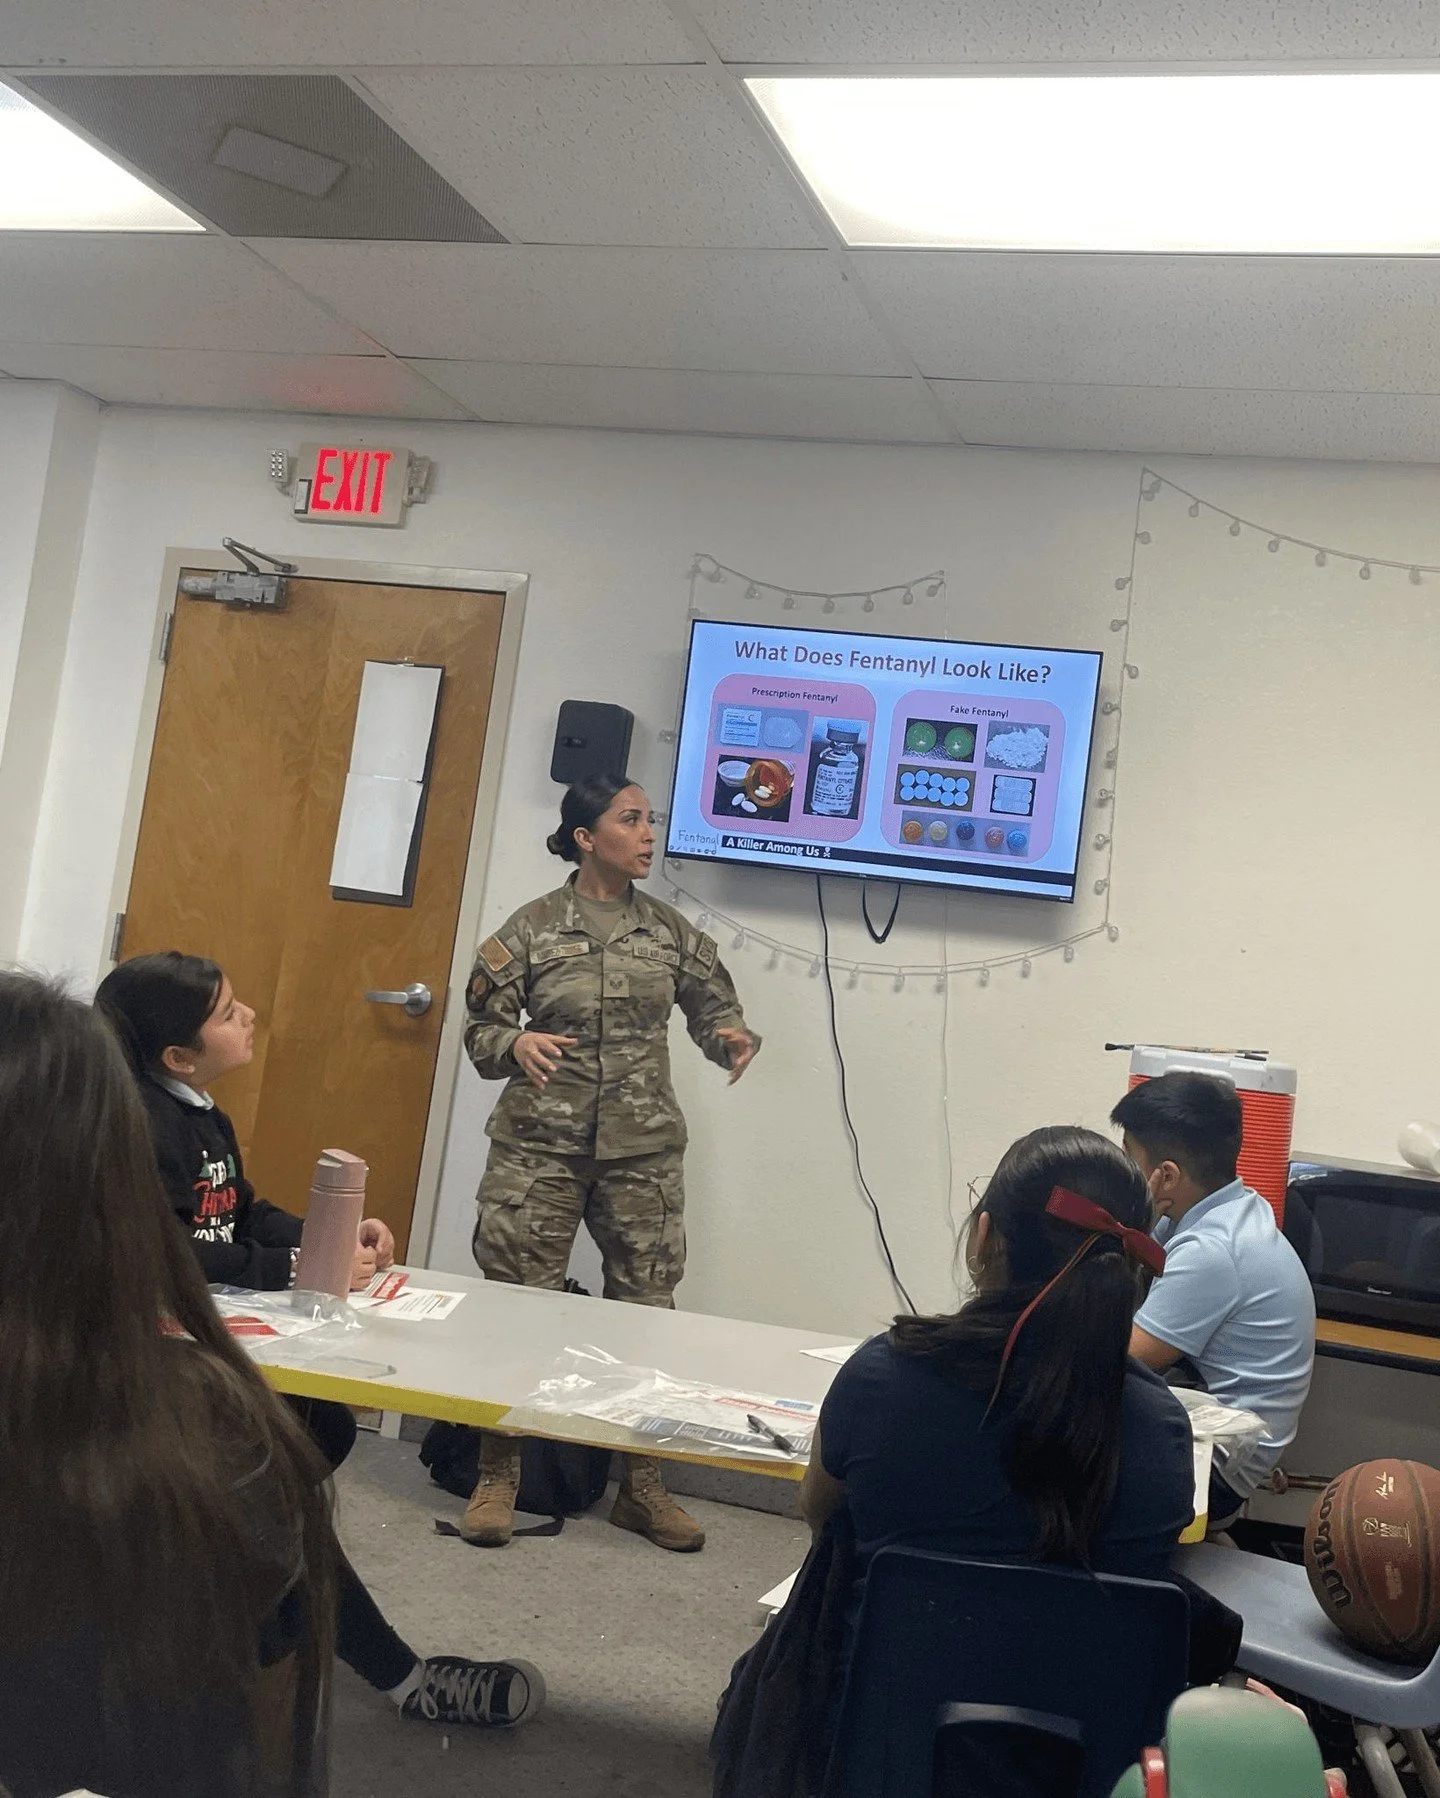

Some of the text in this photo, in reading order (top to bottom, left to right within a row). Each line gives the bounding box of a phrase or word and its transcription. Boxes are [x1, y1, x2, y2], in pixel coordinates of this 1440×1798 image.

[311, 448, 393, 514] EXIT
[735, 640, 1052, 684] What Does Fentanyl Look Like?
[752, 687, 838, 704] Prescription Fentanyl
[950, 705, 1009, 719] Fake Fentanyl
[726, 837, 820, 857] A Killer Among Us
